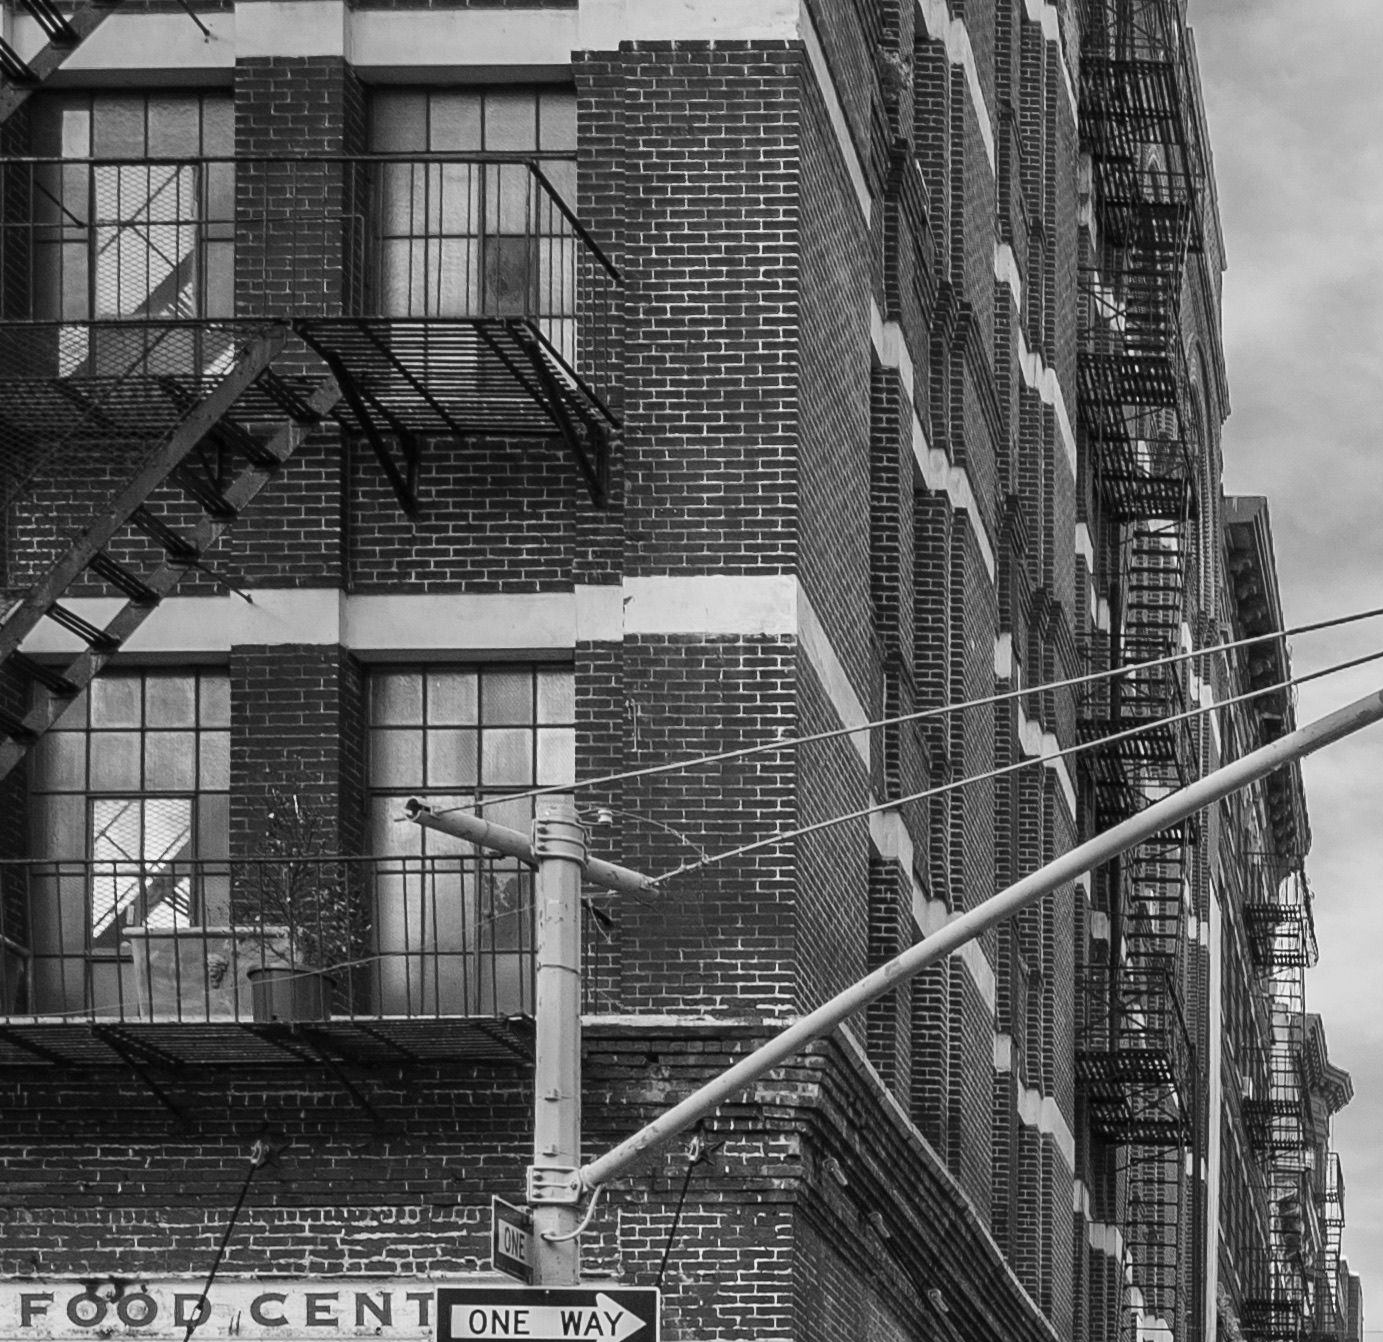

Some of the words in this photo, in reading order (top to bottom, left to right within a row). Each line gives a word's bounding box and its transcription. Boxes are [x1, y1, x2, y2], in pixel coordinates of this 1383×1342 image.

[504, 1227, 525, 1260] ONE
[20, 1292, 212, 1328] FOOD
[250, 1292, 434, 1328] CENT
[469, 1309, 530, 1336] ONE
[561, 1310, 624, 1337] WAY
